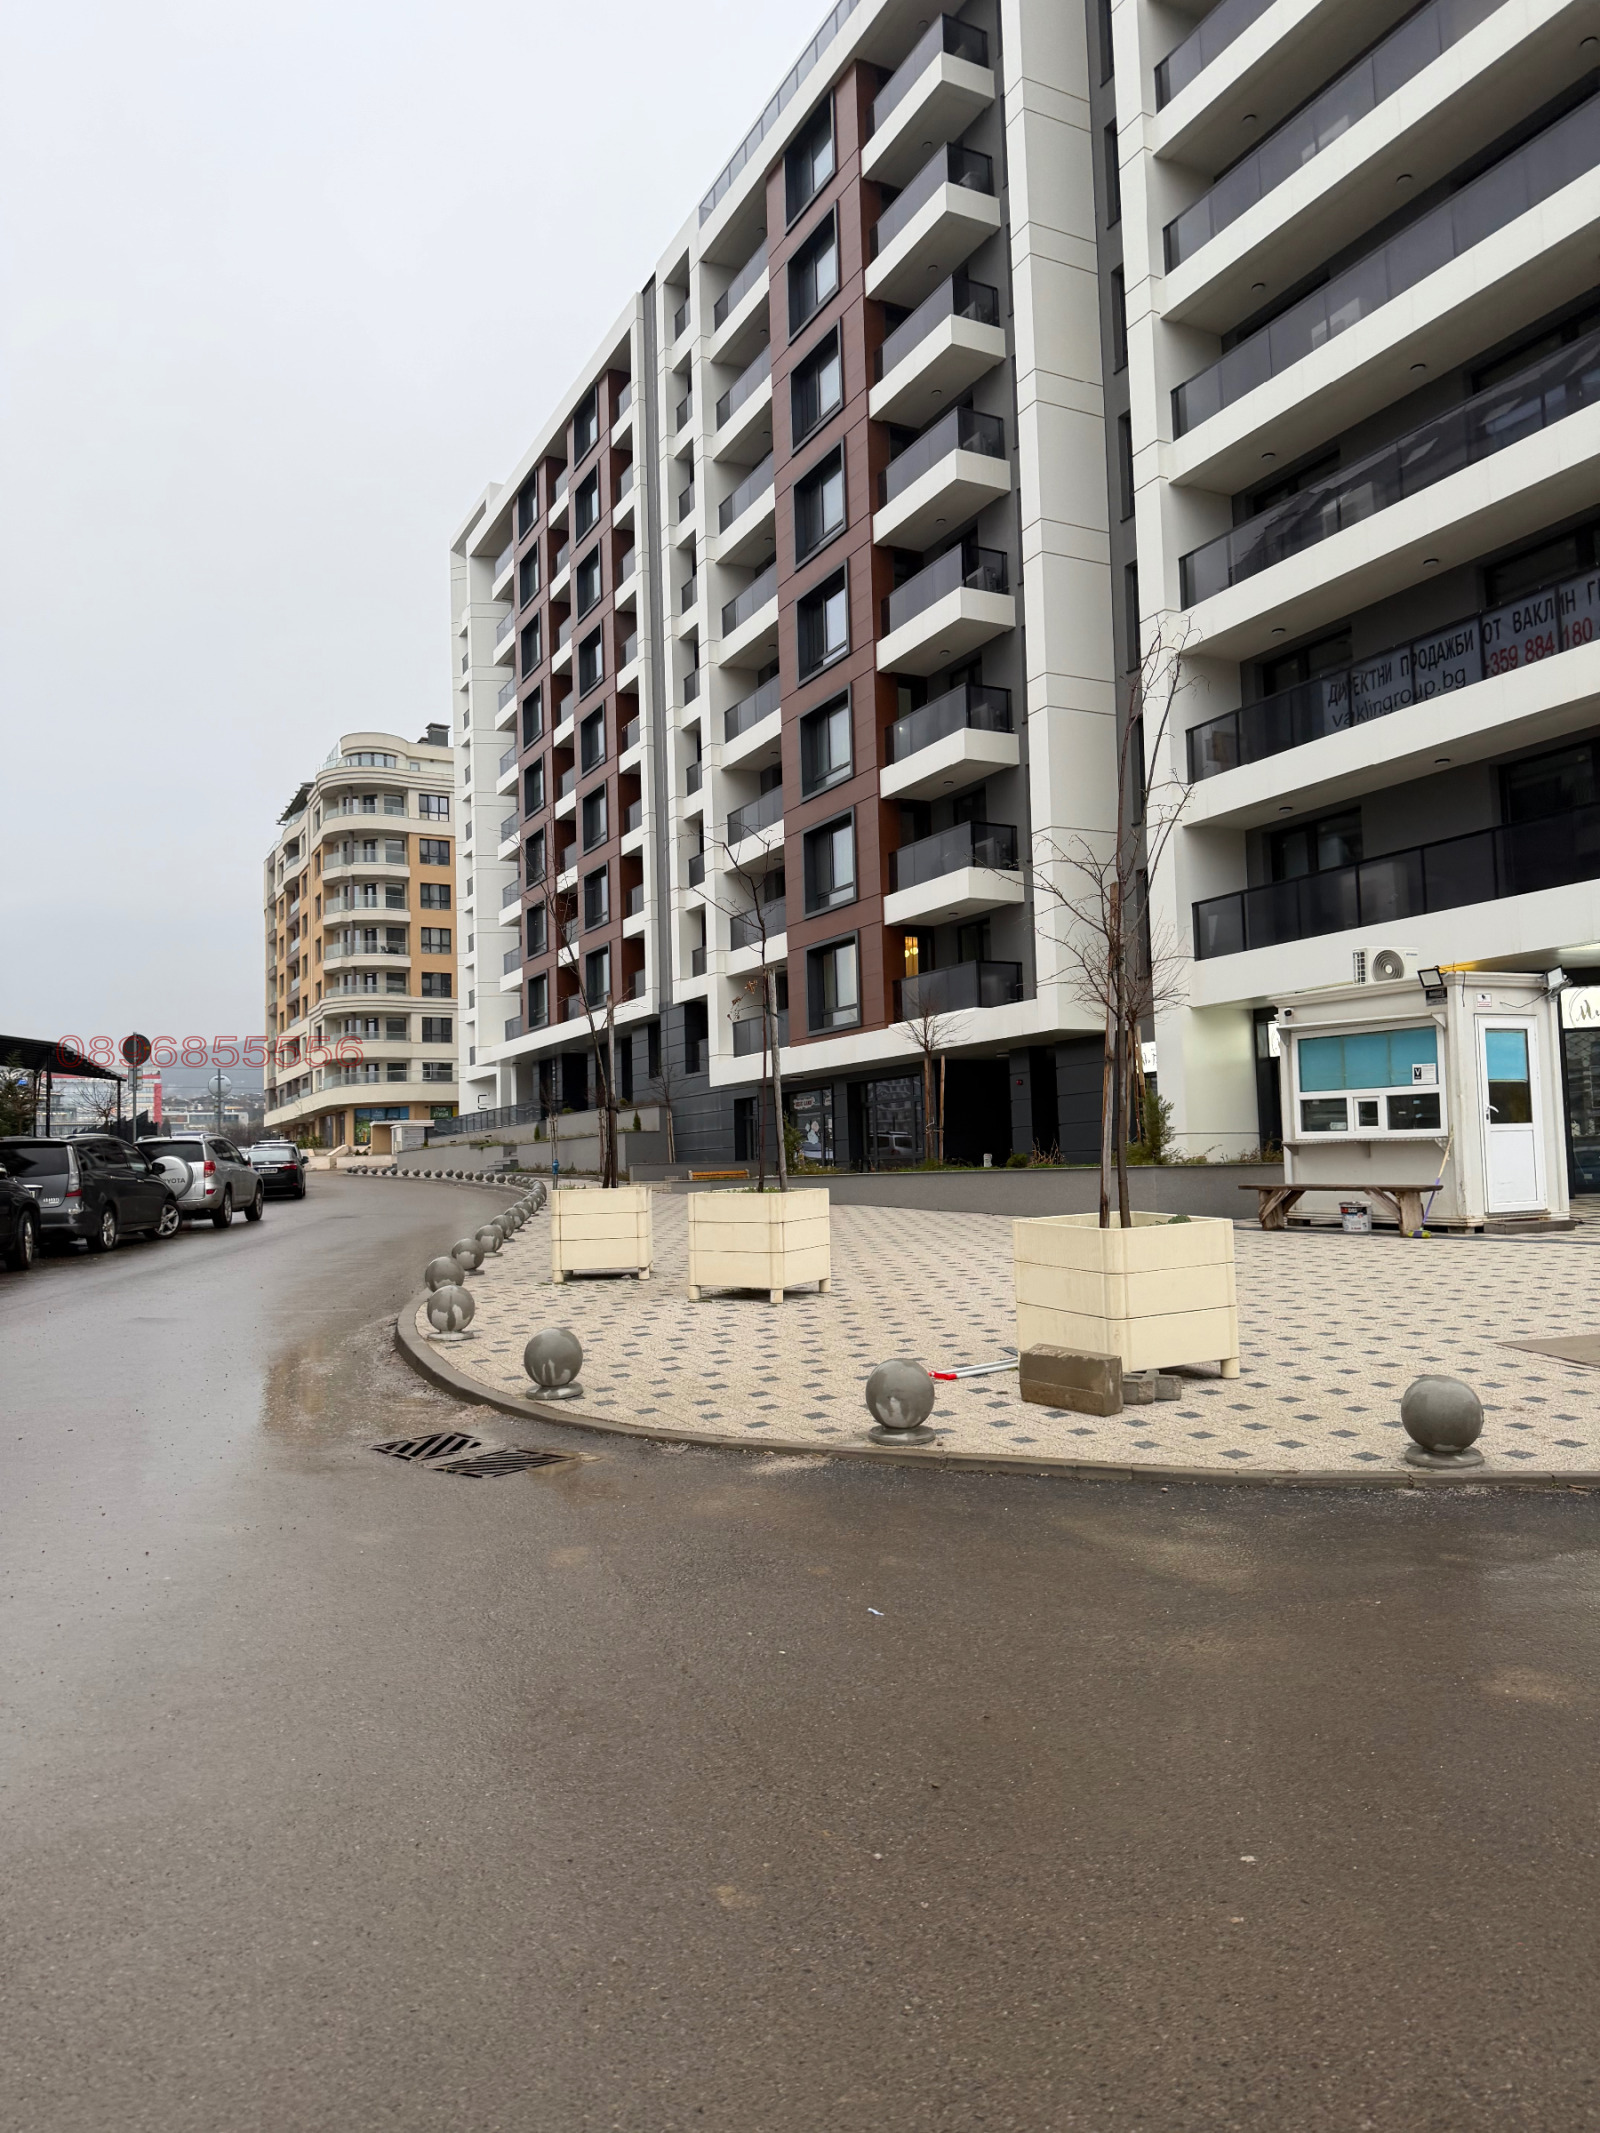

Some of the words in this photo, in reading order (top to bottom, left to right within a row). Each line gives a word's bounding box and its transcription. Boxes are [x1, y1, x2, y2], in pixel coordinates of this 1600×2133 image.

[1328, 662, 1392, 706] ДИЕКТНИ
[1482, 618, 1501, 644] ОТ
[1587, 578, 1600, 606] Г
[1524, 631, 1555, 663] 884
[1563, 617, 1593, 650] 180
